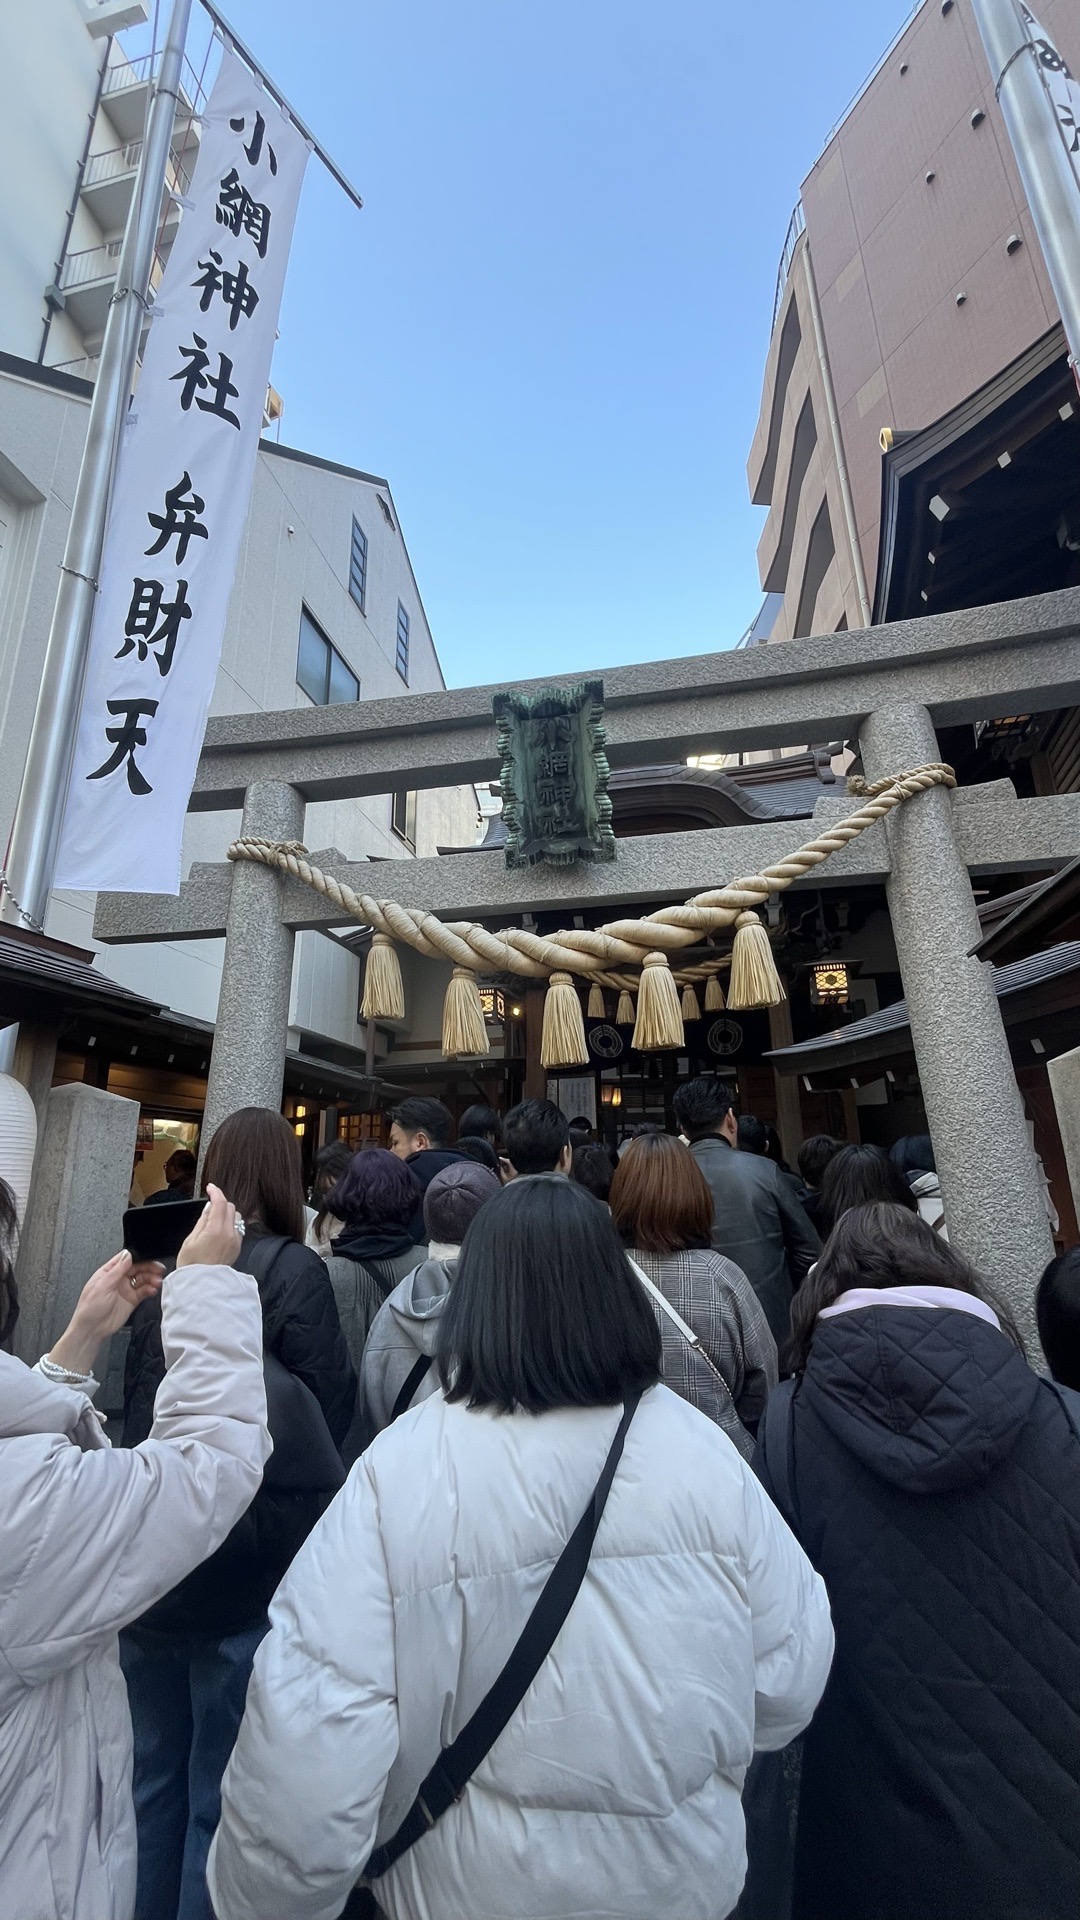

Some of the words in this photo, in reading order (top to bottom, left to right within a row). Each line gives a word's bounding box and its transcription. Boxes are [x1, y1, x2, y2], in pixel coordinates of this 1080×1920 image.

[168, 110, 278, 431] 小網神社
[86, 471, 209, 796] 弁財天
